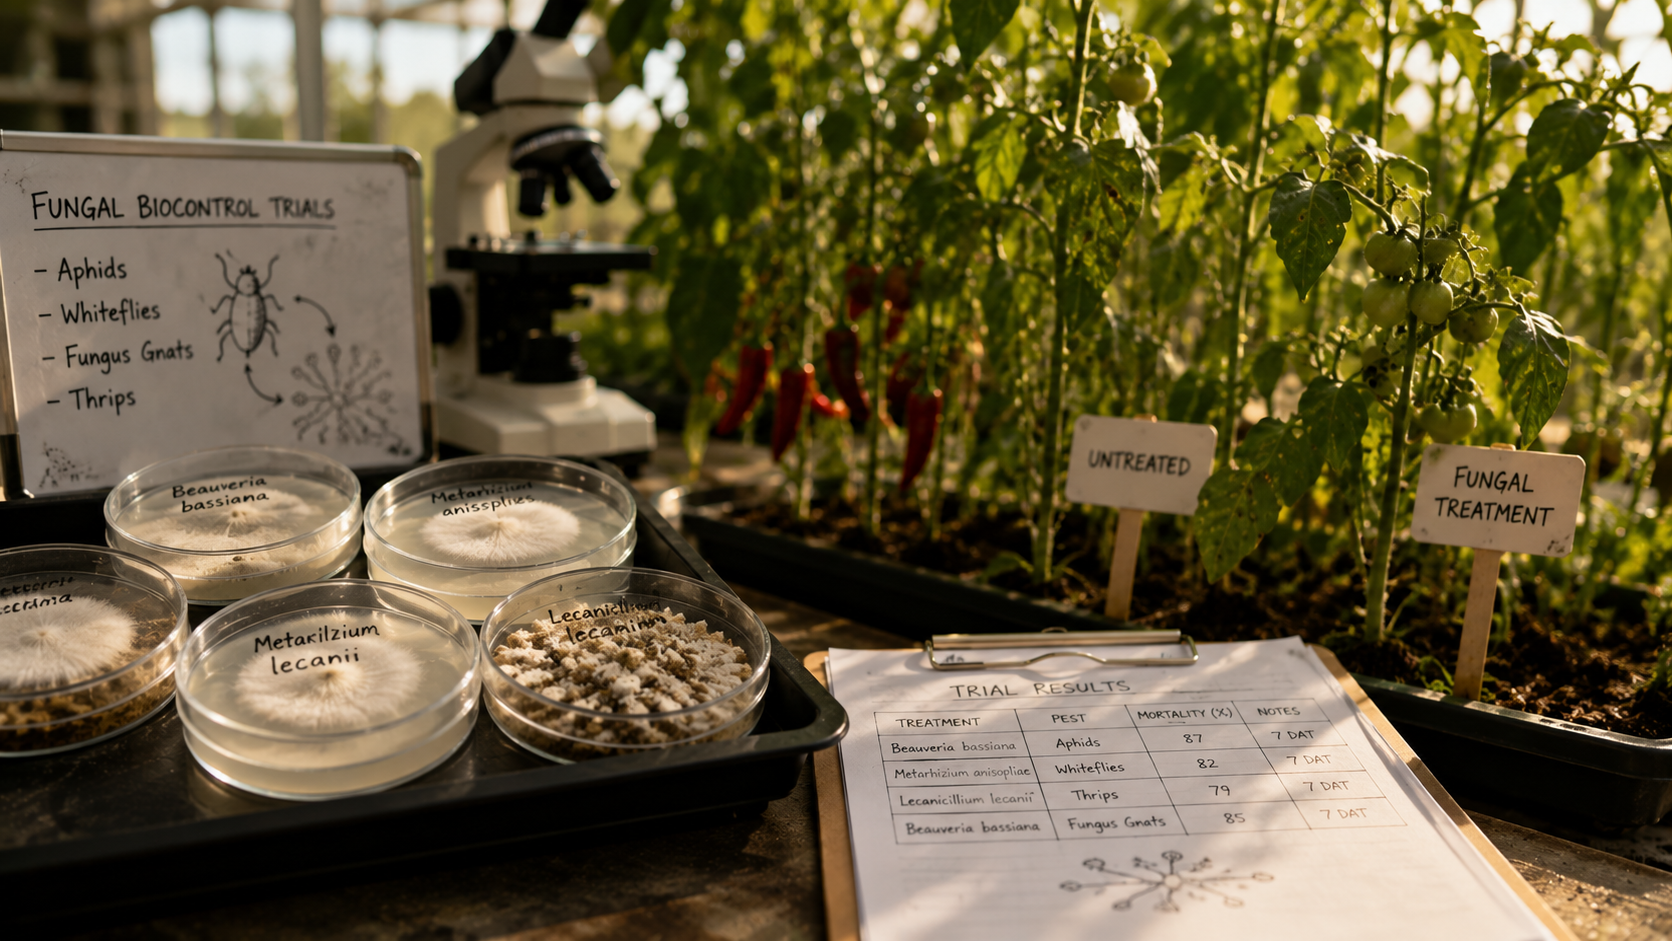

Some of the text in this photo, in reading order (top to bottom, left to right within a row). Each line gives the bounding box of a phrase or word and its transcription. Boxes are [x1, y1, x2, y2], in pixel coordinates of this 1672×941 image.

[32, 191, 335, 220] FUNGAL BIOCONTROL TRIALS
[58, 257, 127, 289] Aphids
[61, 299, 160, 325] Whiteflies
[65, 340, 194, 374] Fungus Gnats
[69, 387, 136, 415] Thrips
[1088, 450, 1191, 477] UNTREATED
[172, 476, 267, 498] Beauveria
[1454, 466, 1534, 494] FUNGAL
[182, 493, 269, 513] bassiana
[1434, 496, 1554, 526] TREATMENT
[271, 647, 359, 675] lecanii
[950, 680, 1131, 698] TRIAL RESULTS
[896, 717, 981, 728] TREATMENT
[1051, 713, 1087, 724] PEST
[1137, 709, 1205, 720] MORTALITY
[1257, 707, 1301, 717] NOTES
[891, 730, 1315, 754] Beauveria bassiana Aphids 87 7 DAT
[894, 754, 1332, 780] Metarhizium anisopliae Whiteflies 82 7 DAT
[899, 780, 1350, 807] Lecanicillium lecanii Thrips 79 7 DAT
[905, 808, 1367, 835] Beauveria bassiana Fungus Gnats 85 7 DAT
